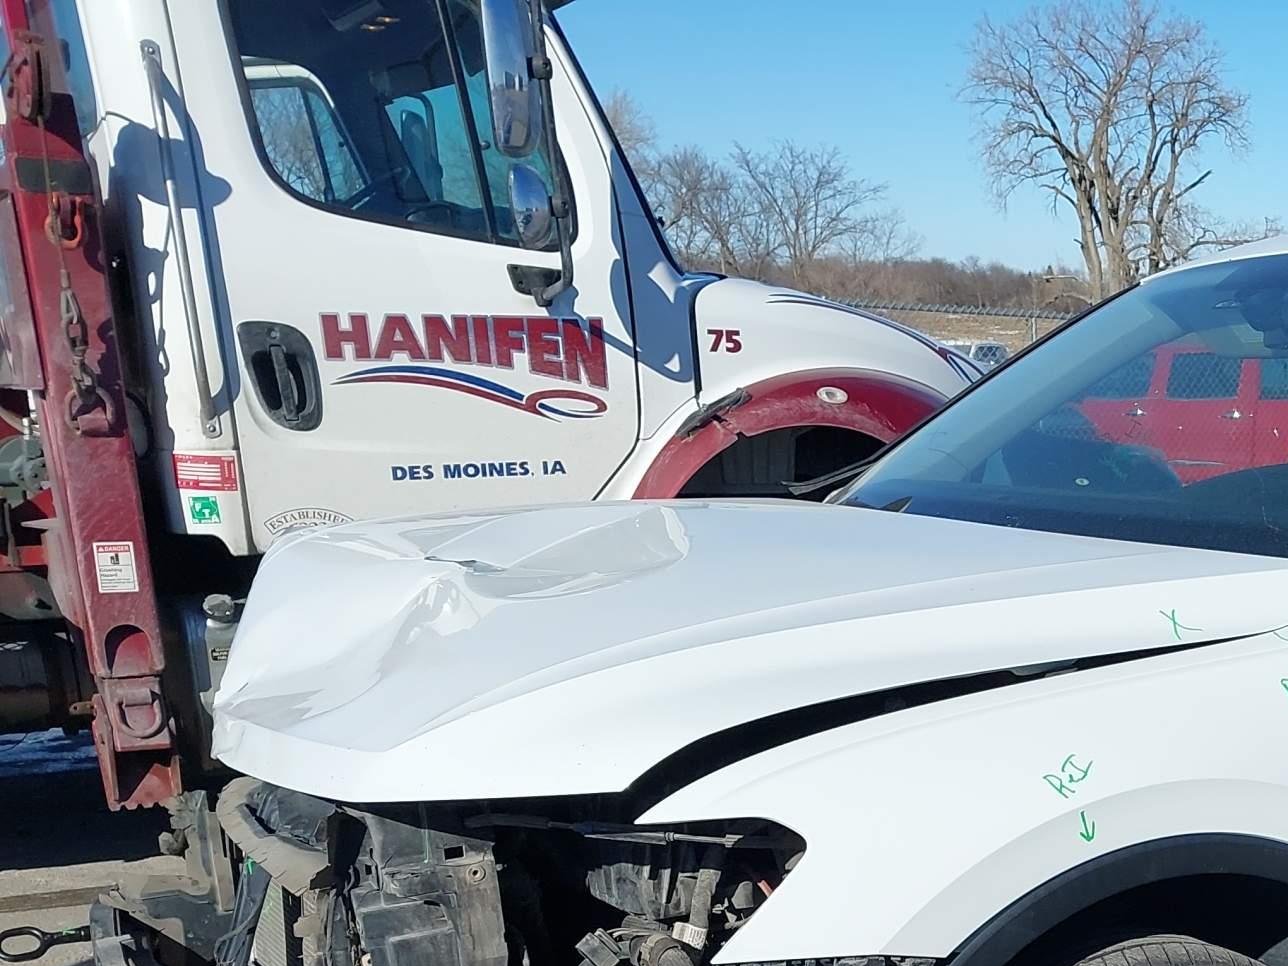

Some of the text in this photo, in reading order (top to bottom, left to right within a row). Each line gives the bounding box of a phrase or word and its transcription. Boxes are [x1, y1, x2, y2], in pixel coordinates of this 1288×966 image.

[319, 312, 609, 391] HANIFEN
[706, 328, 742, 353] 75
[391, 465, 434, 481] DES
[542, 460, 567, 476] IA
